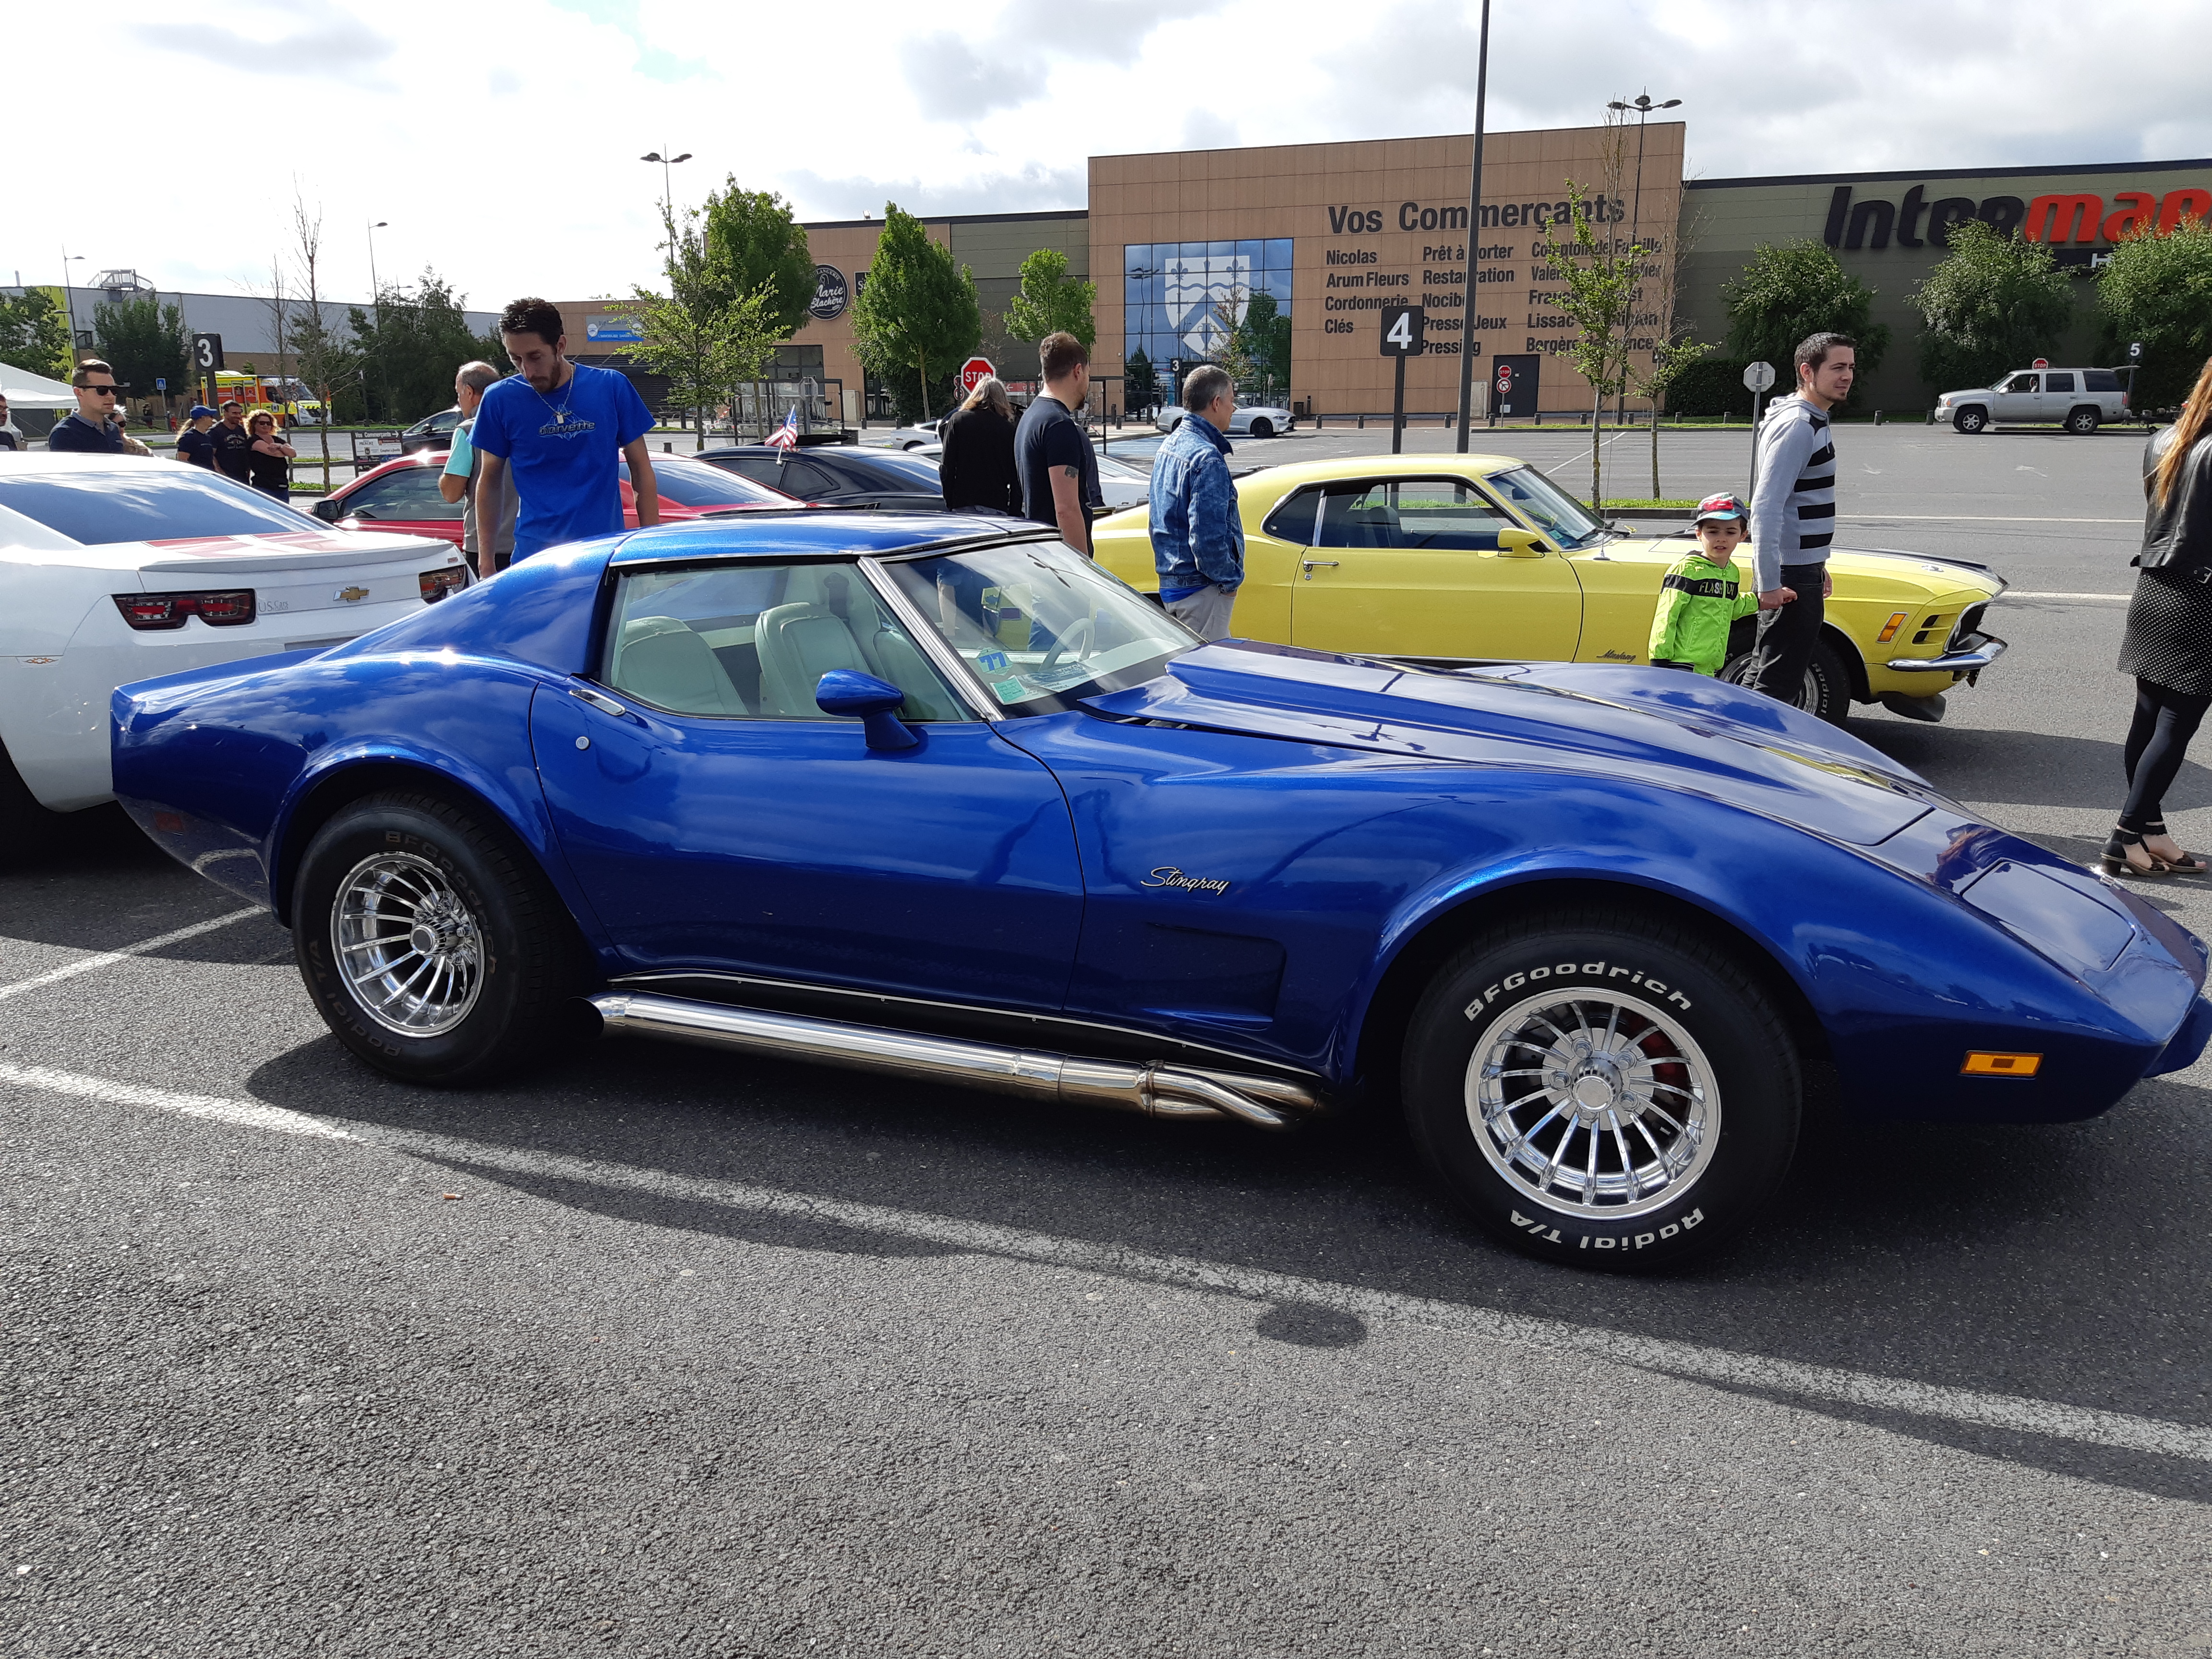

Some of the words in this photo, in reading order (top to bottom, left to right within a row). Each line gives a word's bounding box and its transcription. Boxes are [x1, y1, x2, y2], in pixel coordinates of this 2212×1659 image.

[1328, 205, 1383, 234] Vos
[1825, 184, 2212, 249] Intermar
[1326, 249, 1377, 265] Nicolas
[1422, 245, 1452, 261] Prêt
[1456, 244, 1465, 260] à
[1478, 244, 1514, 259] orter
[1326, 273, 1364, 288] Arum
[1366, 272, 1409, 287] Fleurs
[1423, 267, 1515, 285] Restaation
[1325, 294, 1408, 311] Cordonnerie
[1422, 292, 1465, 308] Nocib
[1325, 318, 1354, 334] Clés
[1474, 315, 1507, 330] Jeux
[1527, 313, 1575, 328] Lissac
[1386, 312, 1413, 349] 4
[197, 338, 214, 367] 3
[1422, 339, 1481, 356] Pressig
[2129, 343, 2140, 356] 5
[1172, 360, 1180, 372] 3
[978, 652, 1007, 671] 77
[1140, 866, 1230, 896] Stingray
[1464, 962, 1692, 1022] BFGoodrich
[1509, 1209, 1562, 1244] T/A
[1579, 1207, 1705, 1251] Radial
